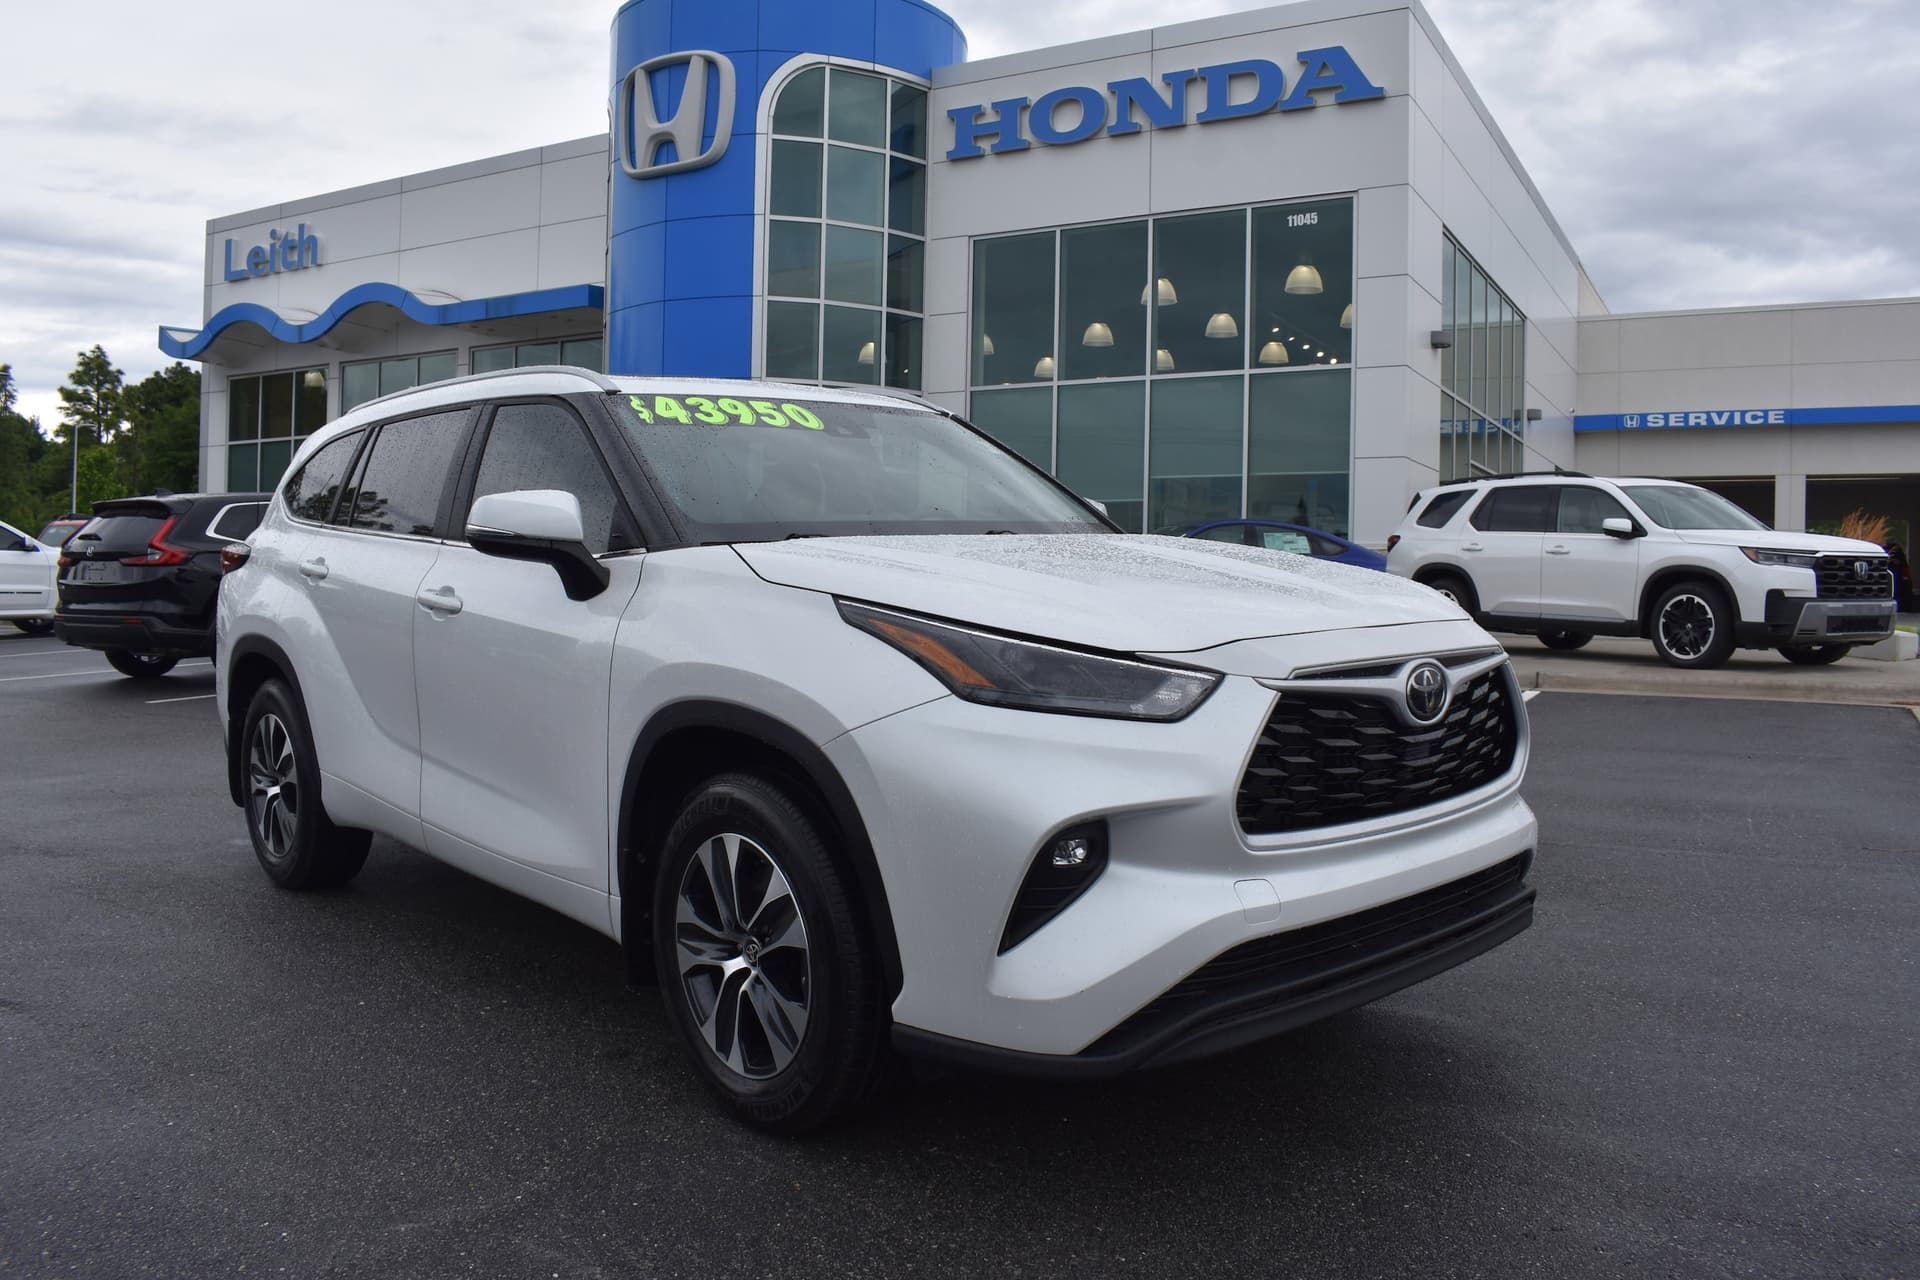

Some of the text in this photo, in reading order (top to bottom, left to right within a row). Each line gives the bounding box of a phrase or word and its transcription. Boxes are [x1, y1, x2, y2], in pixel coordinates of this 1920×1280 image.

[946, 45, 1385, 160] HONDA
[1287, 212, 1318, 227] 11045
[223, 223, 320, 282] Leith
[629, 395, 824, 430] $43950
[1646, 410, 1785, 428] SERVICE
